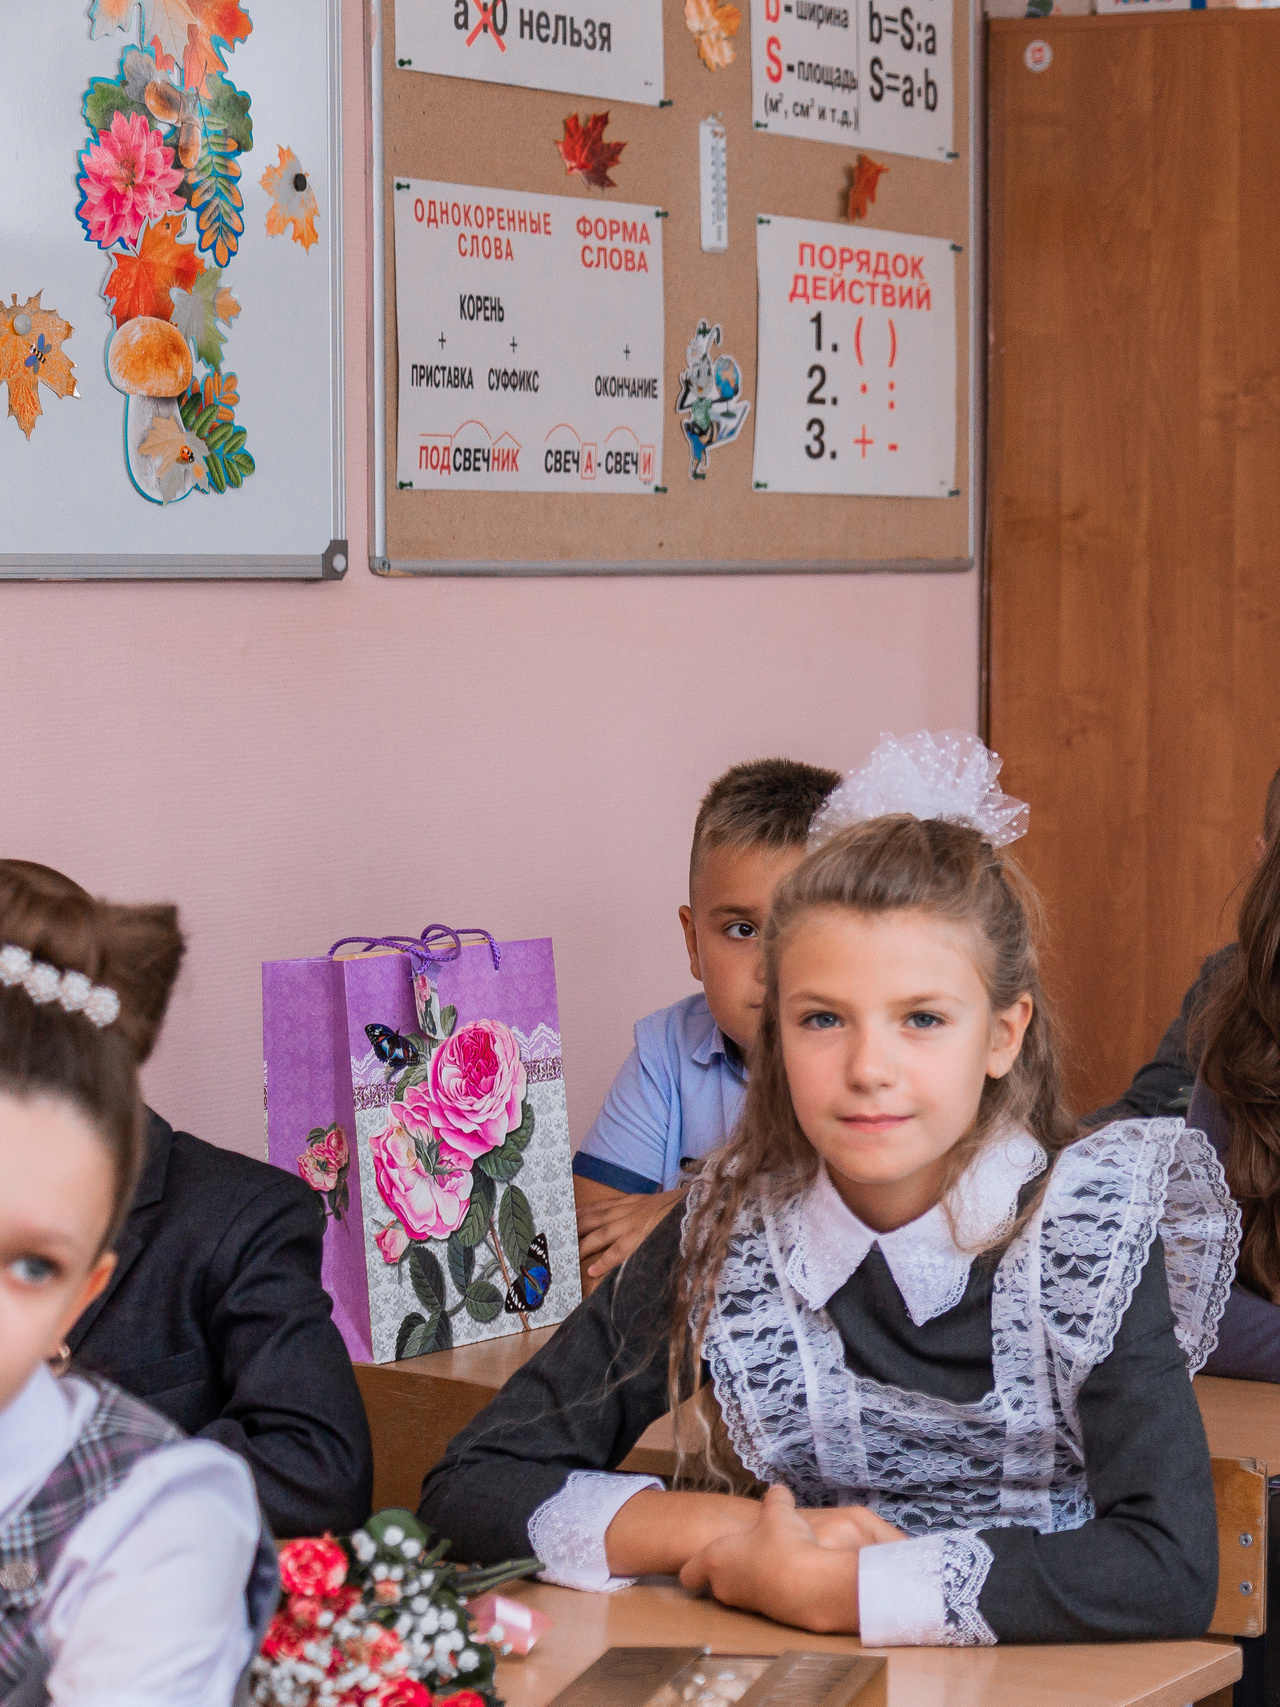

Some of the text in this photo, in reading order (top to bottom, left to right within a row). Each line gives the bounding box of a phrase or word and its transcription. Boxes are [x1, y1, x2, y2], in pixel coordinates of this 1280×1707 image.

[520, 8, 611, 52] нельзя
[797, 1, 849, 29] ширина
[766, 36, 782, 83] S
[798, 61, 858, 92] площадь
[413, 198, 552, 235] ОДНОКОРЕННЫЕ
[576, 215, 651, 245] ФОРМА
[457, 233, 514, 261] СЛОВА
[580, 245, 649, 273] СЛОВА
[799, 242, 925, 280] ПОРЯДОК
[460, 294, 504, 322] КОРЕНЬ
[789, 274, 932, 311] ДЕЙСТВИЙ
[810, 311, 838, 352] 1.
[412, 364, 539, 392] ПРИСТАВКА СУФФИКС
[595, 375, 658, 399] ОКОНЧАНИЕ
[807, 364, 837, 405] 2.
[805, 418, 836, 459] 3.
[419, 446, 519, 474] ПОДСВЕЧНИК
